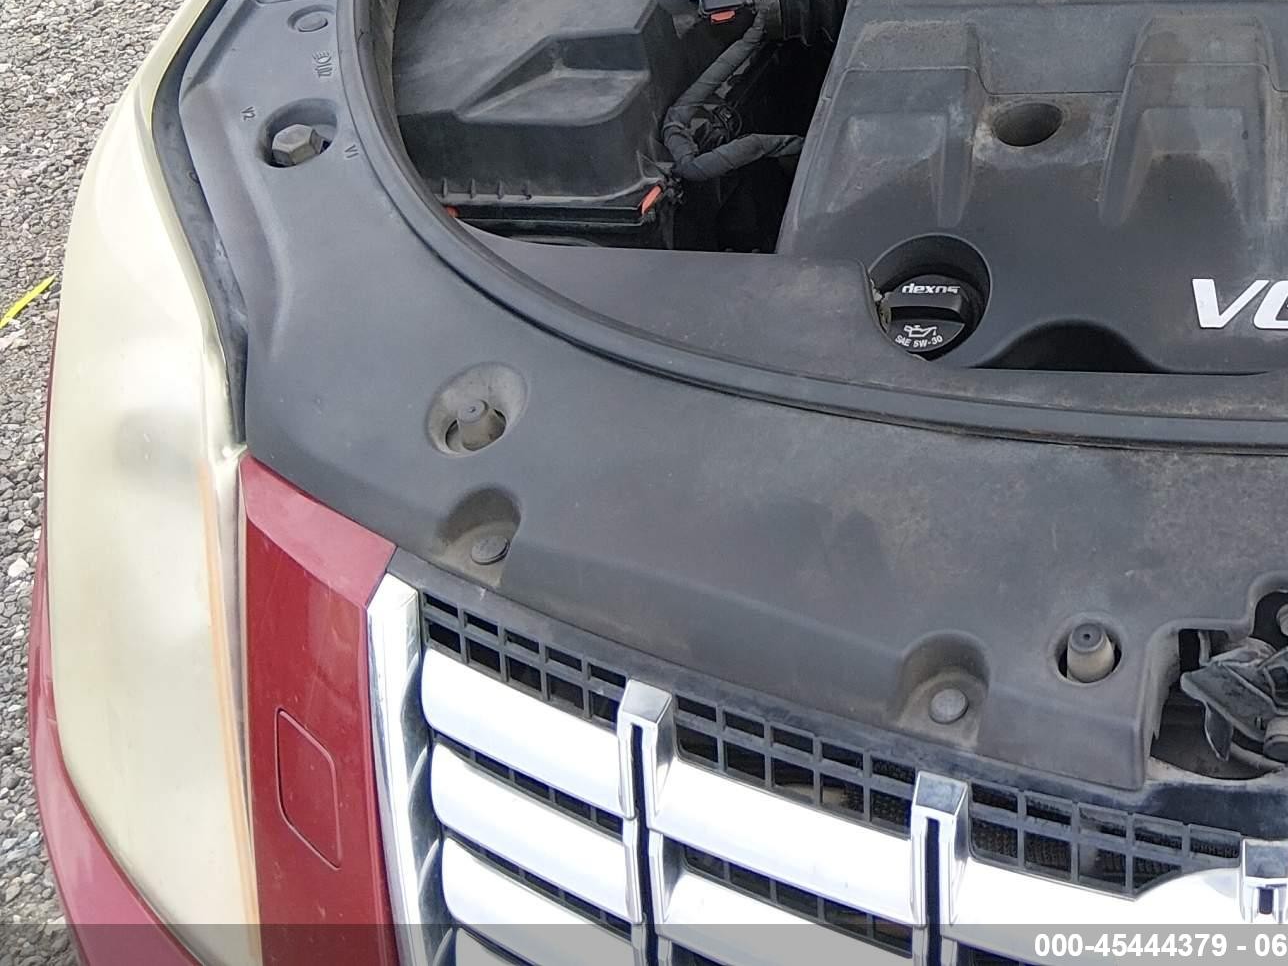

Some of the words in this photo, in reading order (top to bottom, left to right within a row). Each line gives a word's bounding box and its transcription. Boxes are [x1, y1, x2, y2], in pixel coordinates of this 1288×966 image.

[901, 283, 960, 294] dexos
[894, 334, 911, 347] SAE
[913, 335, 943, 348] 5W-30
